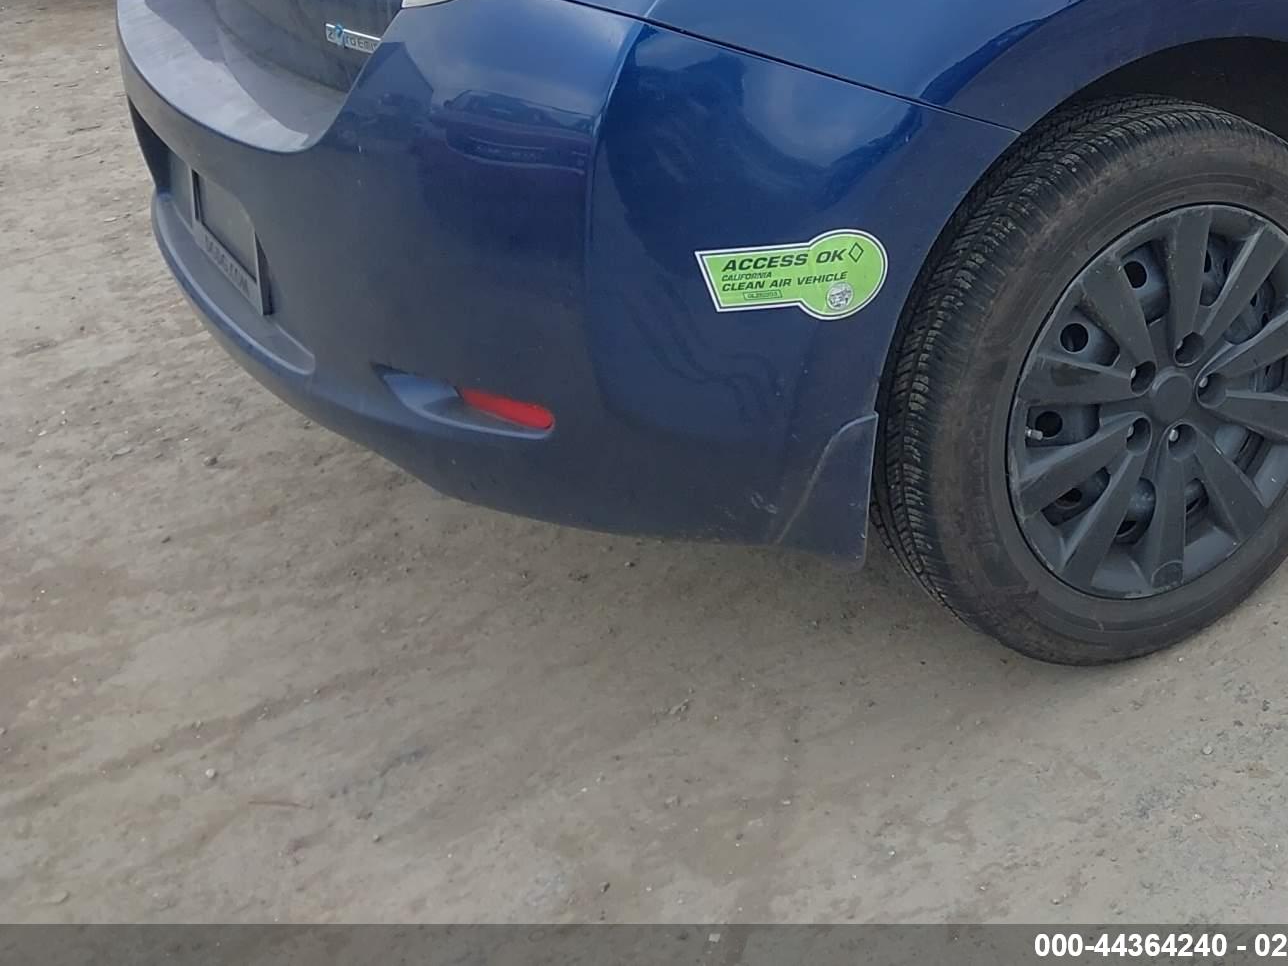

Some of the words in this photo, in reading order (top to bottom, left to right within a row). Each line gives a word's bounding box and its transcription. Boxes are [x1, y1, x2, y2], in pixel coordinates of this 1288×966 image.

[722, 254, 808, 271] ACCESS
[816, 249, 847, 263] OK
[721, 272, 772, 281] CALIFORNIA
[722, 281, 765, 291] CLEAN
[769, 278, 792, 289] AIR
[797, 272, 848, 285] VEHICLE
